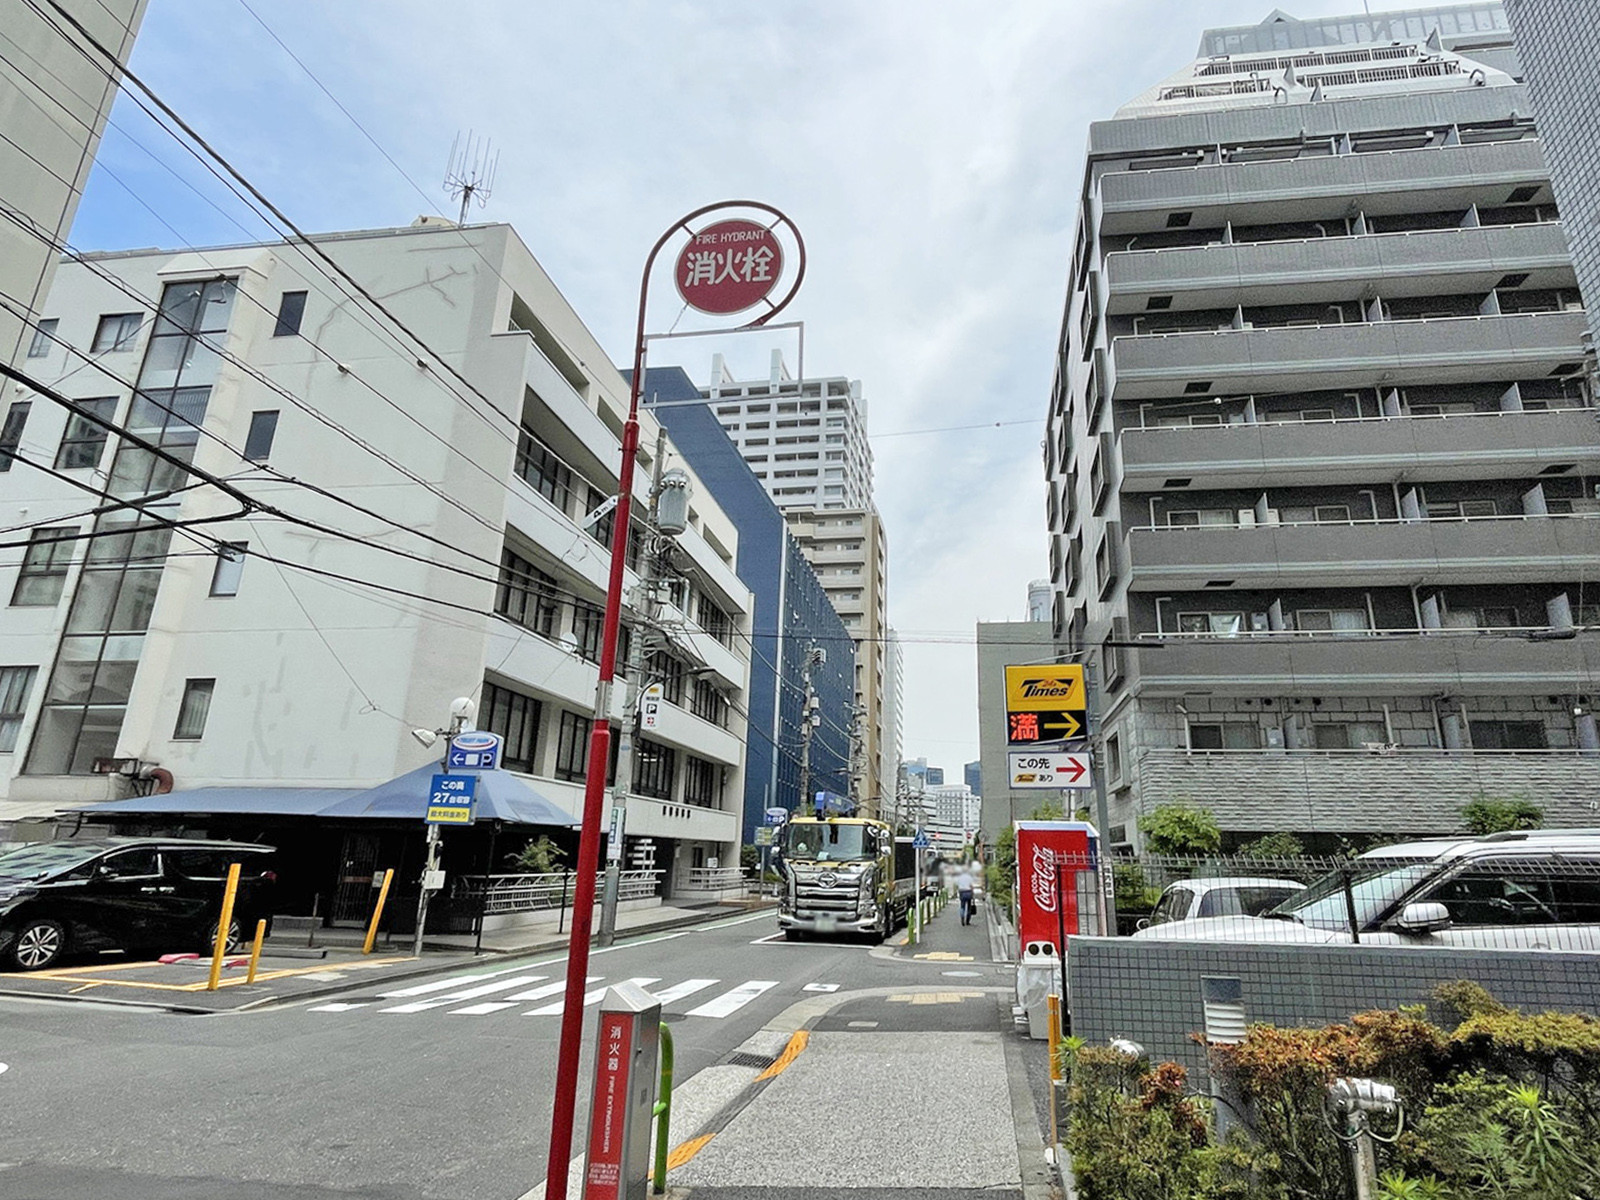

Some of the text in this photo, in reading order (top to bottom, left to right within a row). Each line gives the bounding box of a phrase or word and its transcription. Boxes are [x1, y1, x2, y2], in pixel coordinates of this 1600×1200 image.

[696, 229, 766, 245] FIRE HYDRANT
[684, 245, 774, 287] 消火栓
[1020, 679, 1074, 698] Times
[1010, 713, 1040, 740] 満
[481, 753, 492, 767] P
[1018, 758, 1050, 769] この先
[1039, 774, 1054, 782] あり
[608, 1026, 621, 1071] 消火器
